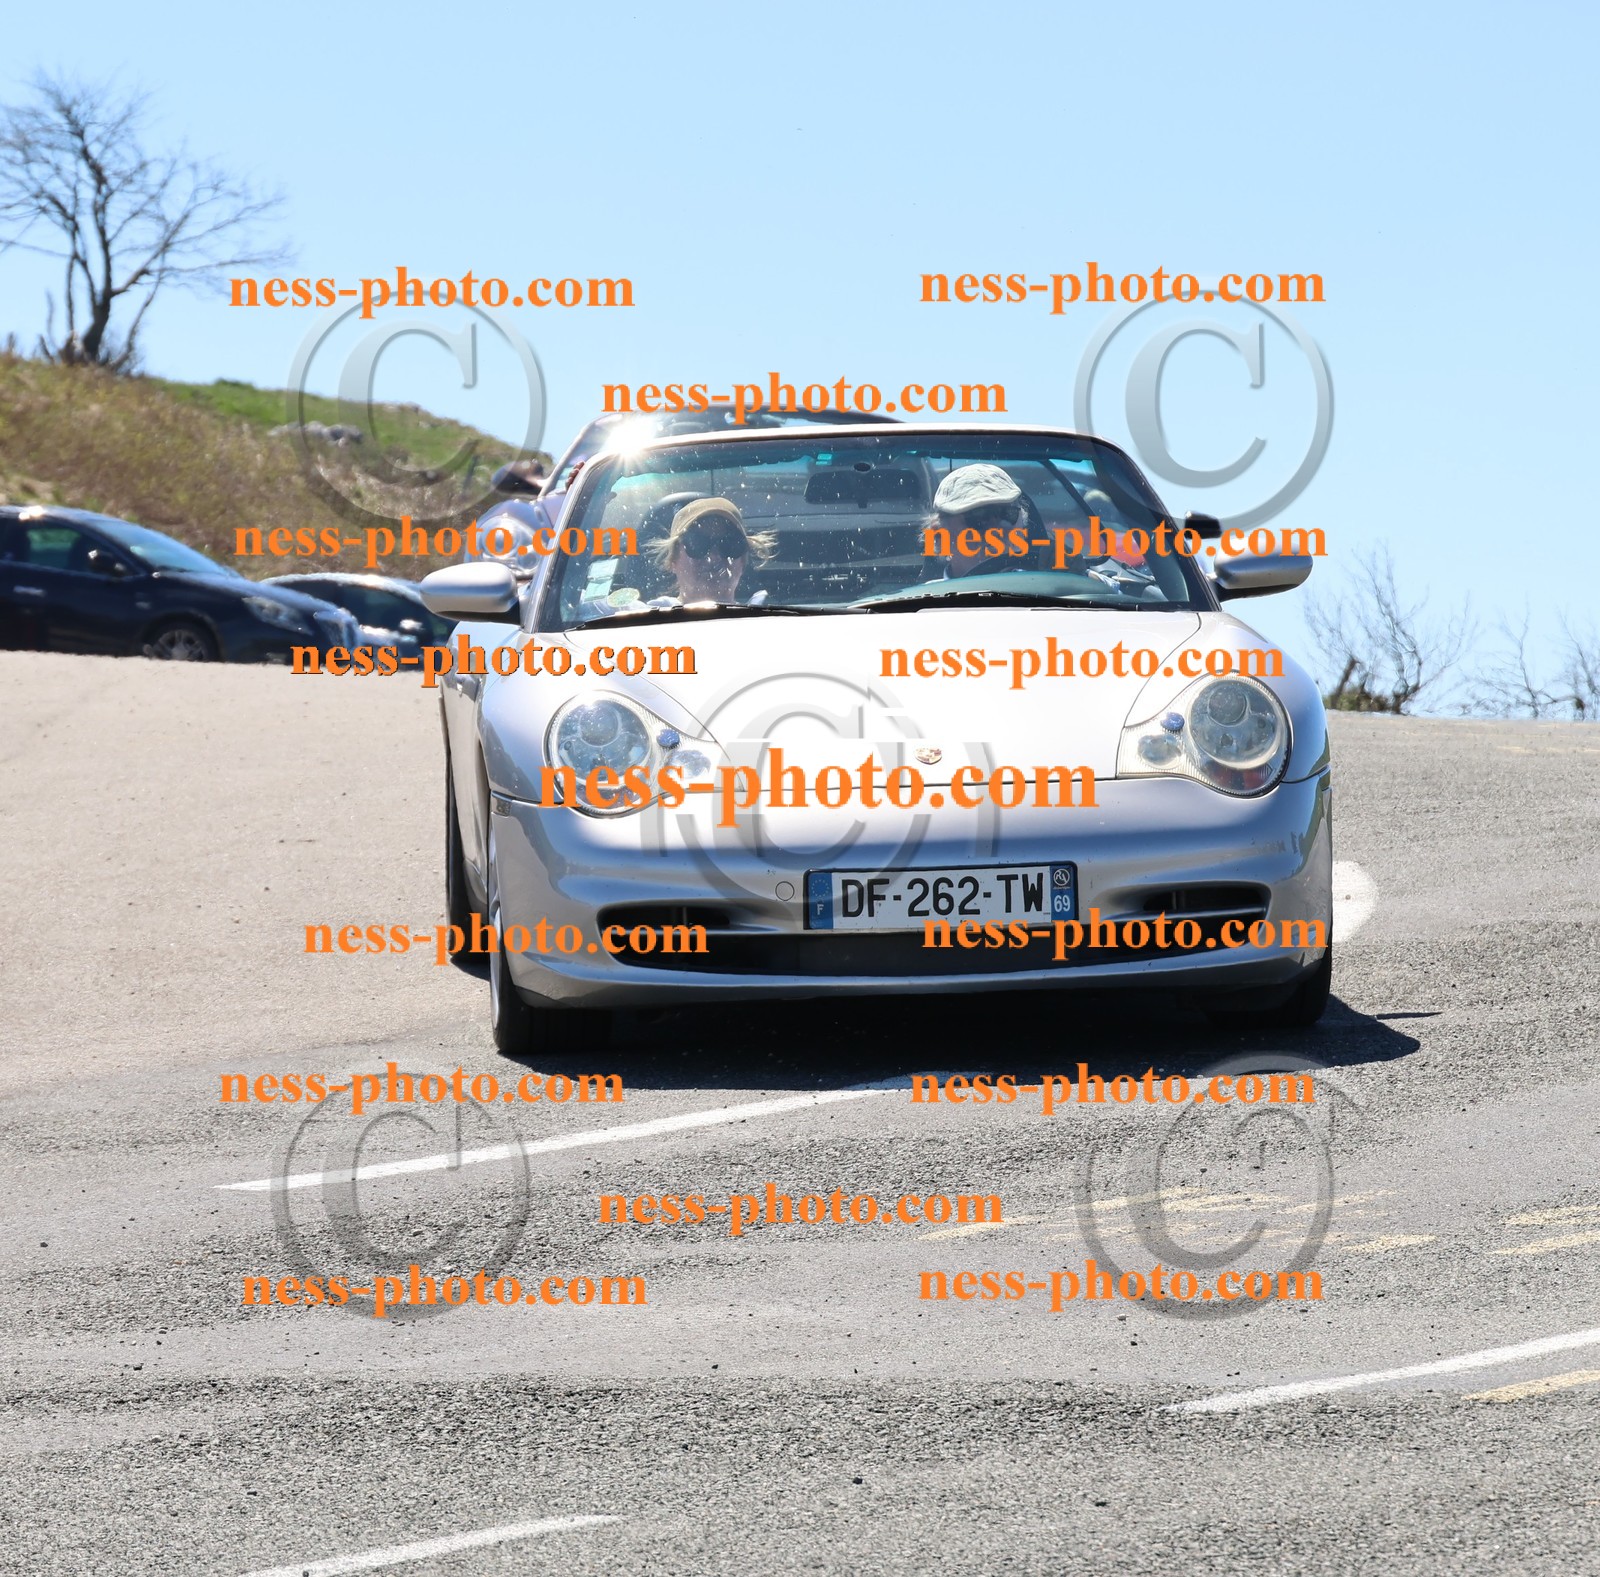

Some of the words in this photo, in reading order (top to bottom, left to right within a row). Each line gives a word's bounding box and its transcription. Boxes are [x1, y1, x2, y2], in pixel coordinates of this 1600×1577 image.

[817, 903, 824, 916] F
[841, 872, 1043, 917] DF-262-TW
[1054, 895, 1071, 912] 69
